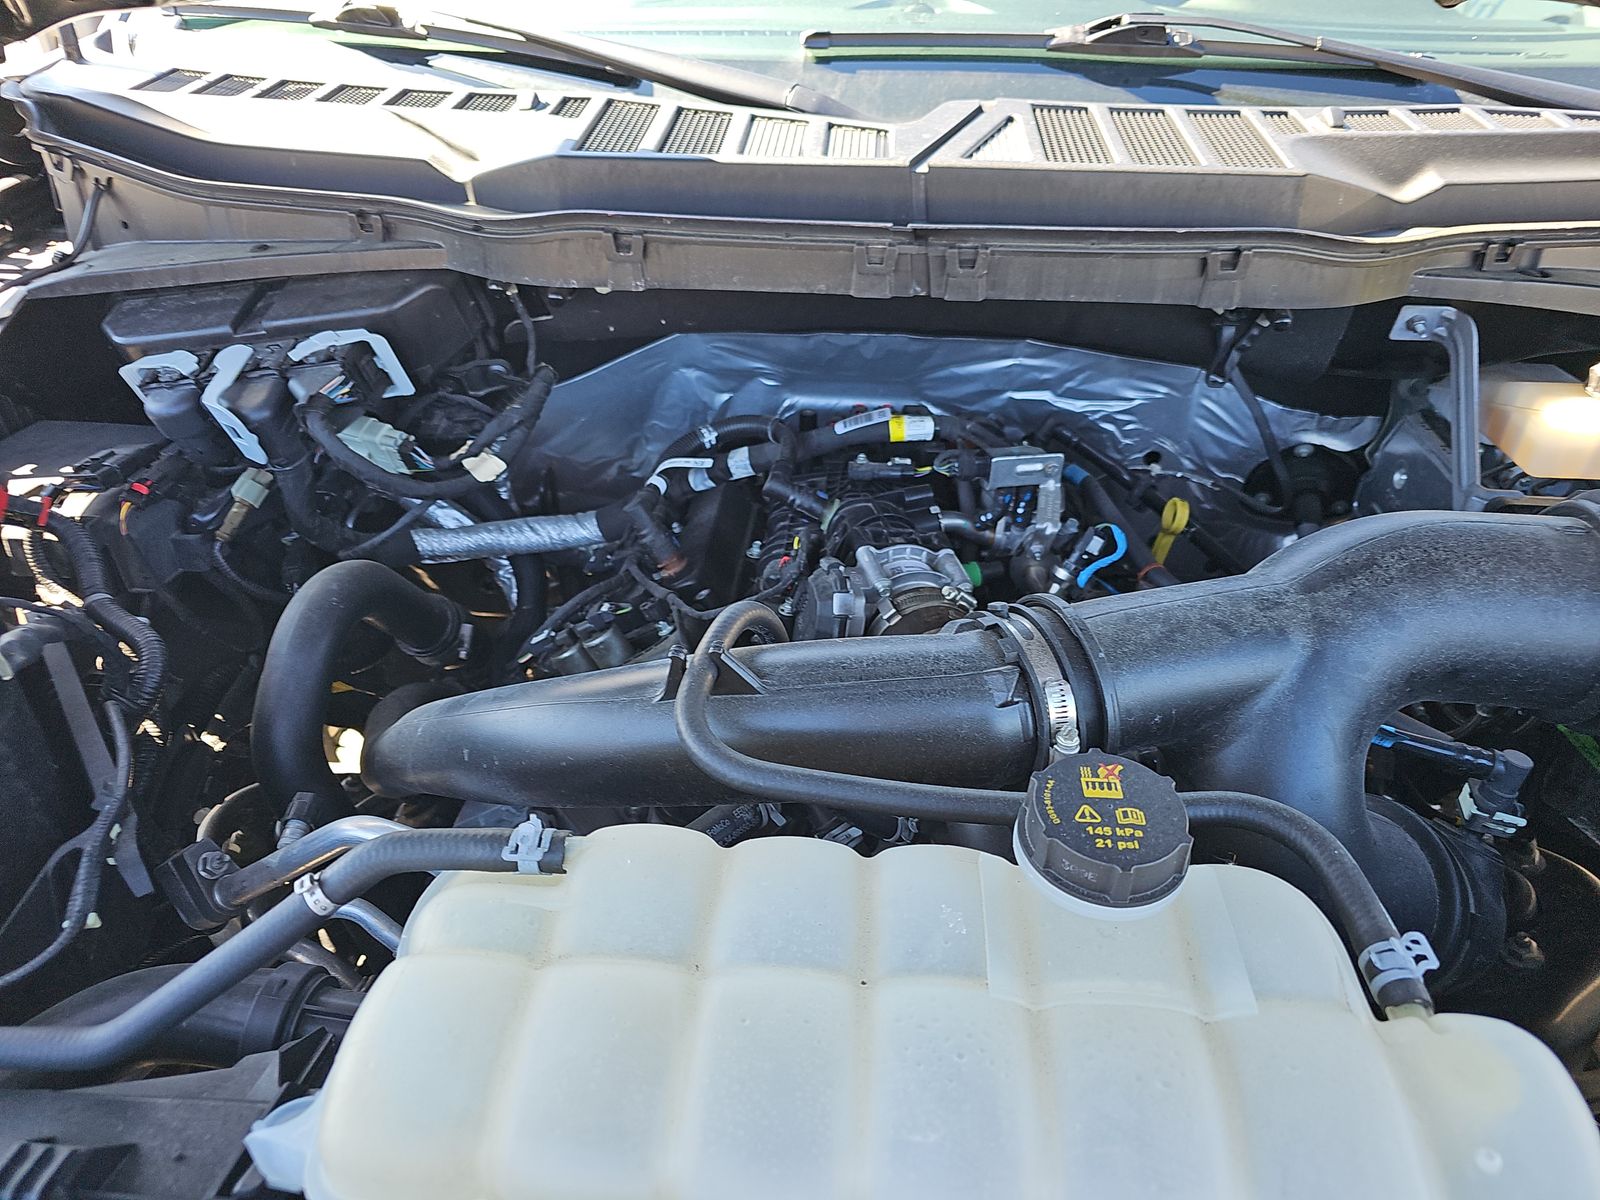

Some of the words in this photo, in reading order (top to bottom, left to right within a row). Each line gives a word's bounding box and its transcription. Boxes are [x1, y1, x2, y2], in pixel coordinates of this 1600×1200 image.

[1086, 826, 1113, 836] 145
[1115, 827, 1144, 837] kPa
[1095, 838, 1112, 849] 21
[1117, 840, 1140, 851] psi
